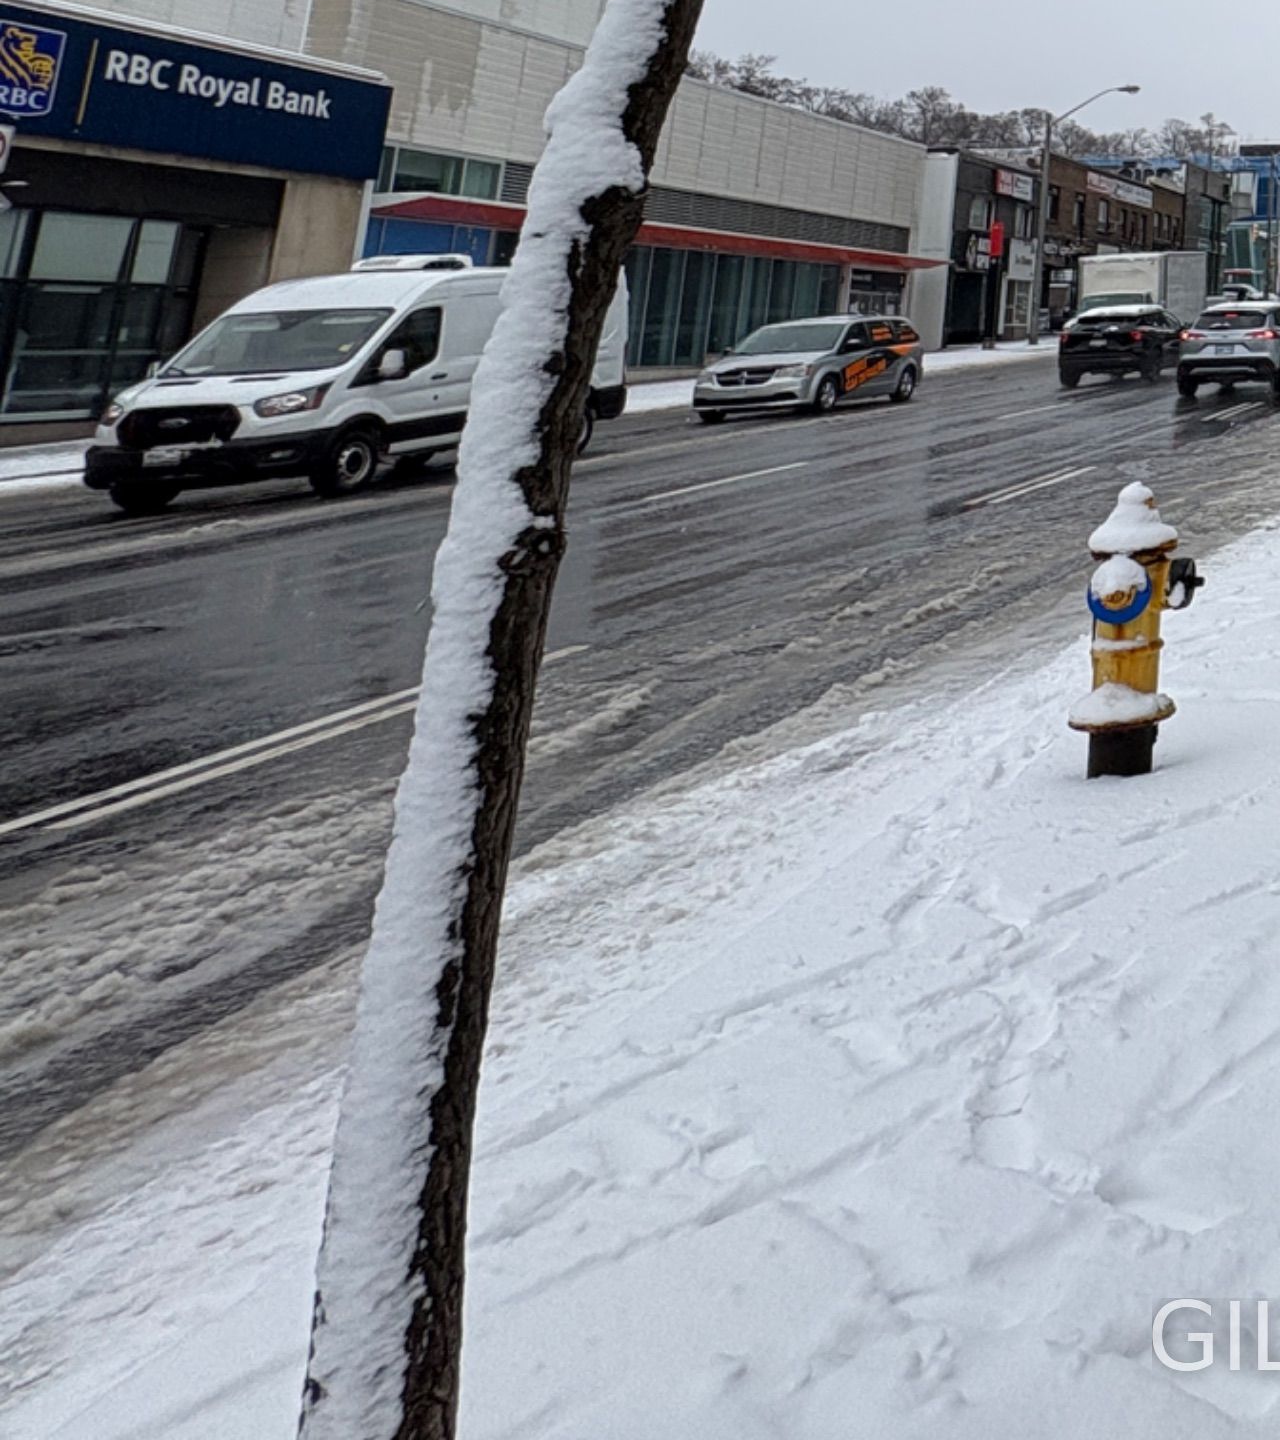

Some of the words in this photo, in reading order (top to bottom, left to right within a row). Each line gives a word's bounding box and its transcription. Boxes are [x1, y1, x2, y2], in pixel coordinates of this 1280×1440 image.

[104, 49, 173, 90] RBC
[177, 63, 260, 107] Royal
[266, 79, 332, 119] Bank
